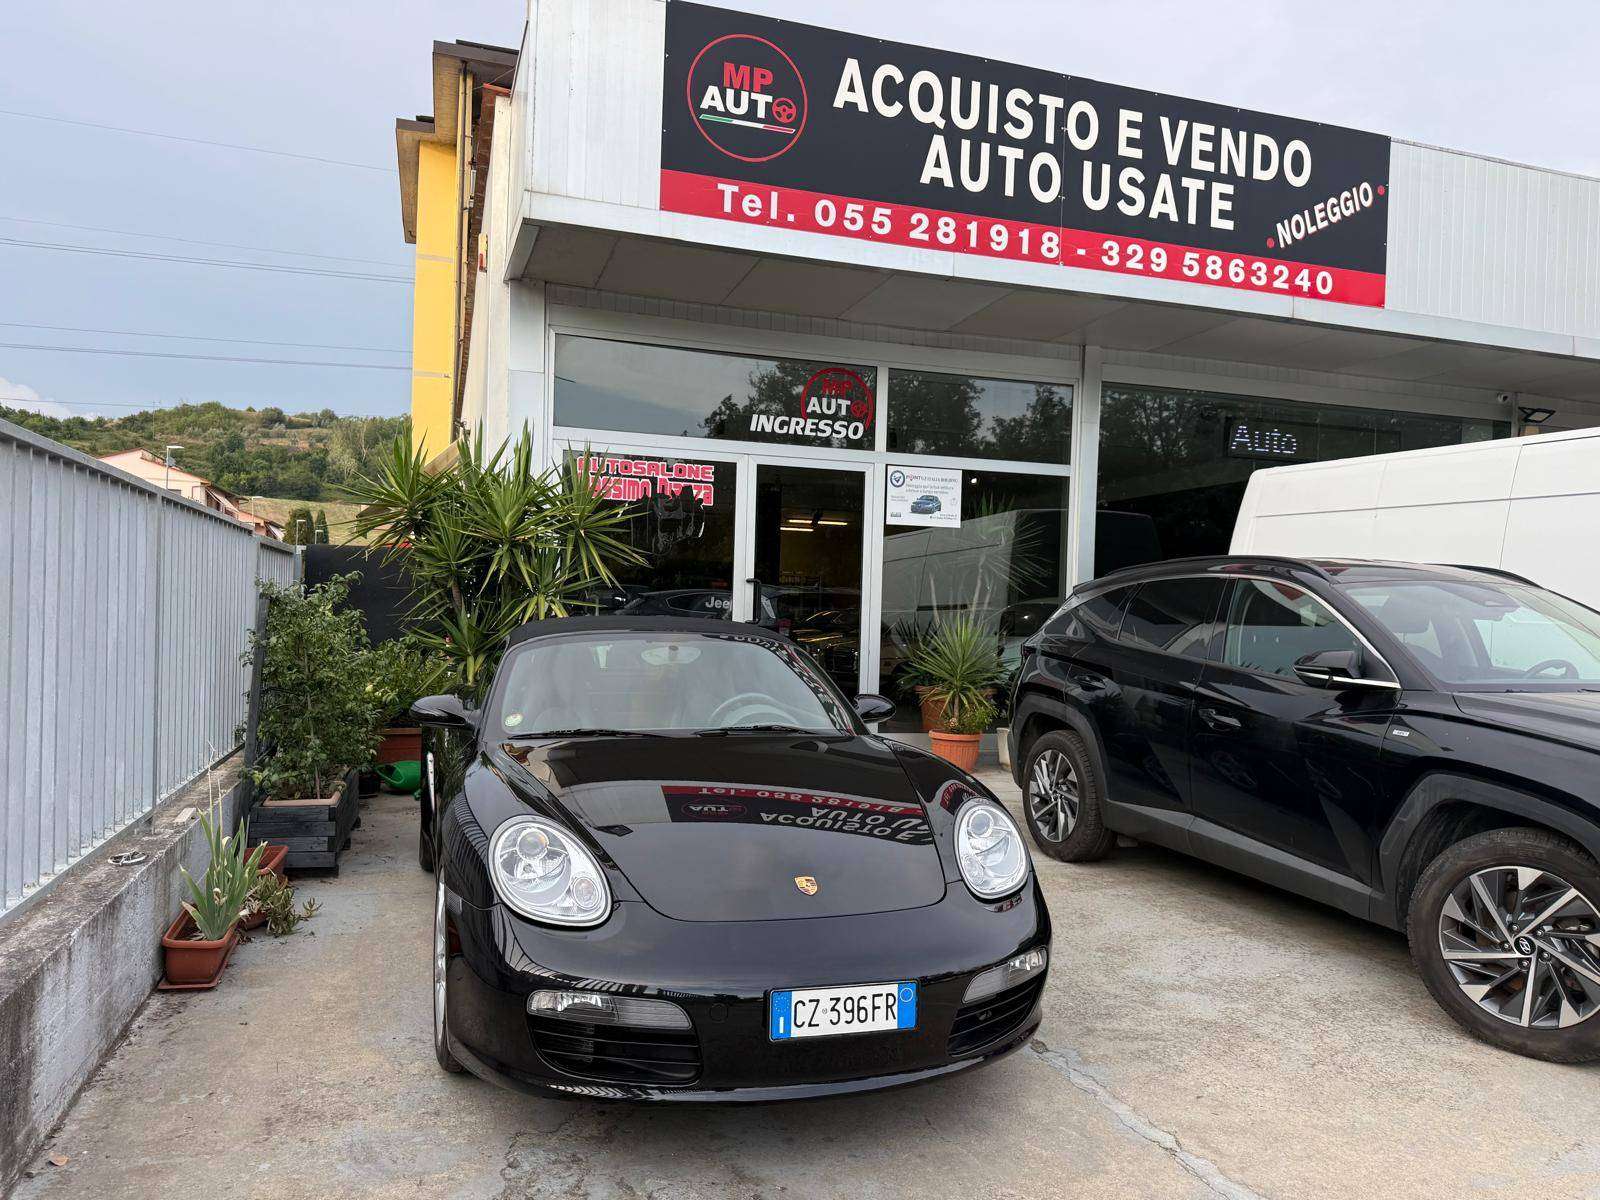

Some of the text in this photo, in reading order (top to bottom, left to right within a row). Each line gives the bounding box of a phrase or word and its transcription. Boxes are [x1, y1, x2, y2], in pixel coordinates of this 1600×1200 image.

[723, 61, 774, 93] MP
[833, 57, 1312, 188] ACQUISTO E VENDO
[920, 134, 1235, 231] AUTO USATE
[1275, 182, 1374, 249] NOLEGGIO
[717, 183, 795, 222] Tel.
[814, 199, 892, 235] 055
[909, 213, 1060, 259] 281918
[1101, 240, 1167, 273] 329
[1182, 251, 1333, 295] 5863240
[821, 378, 853, 400] MP
[749, 413, 865, 440] INGRESSO
[1231, 425, 1297, 454] Auto
[577, 456, 715, 480] AUTOSALONE
[793, 998, 821, 1029] CZ
[829, 992, 897, 1026] 396FR
